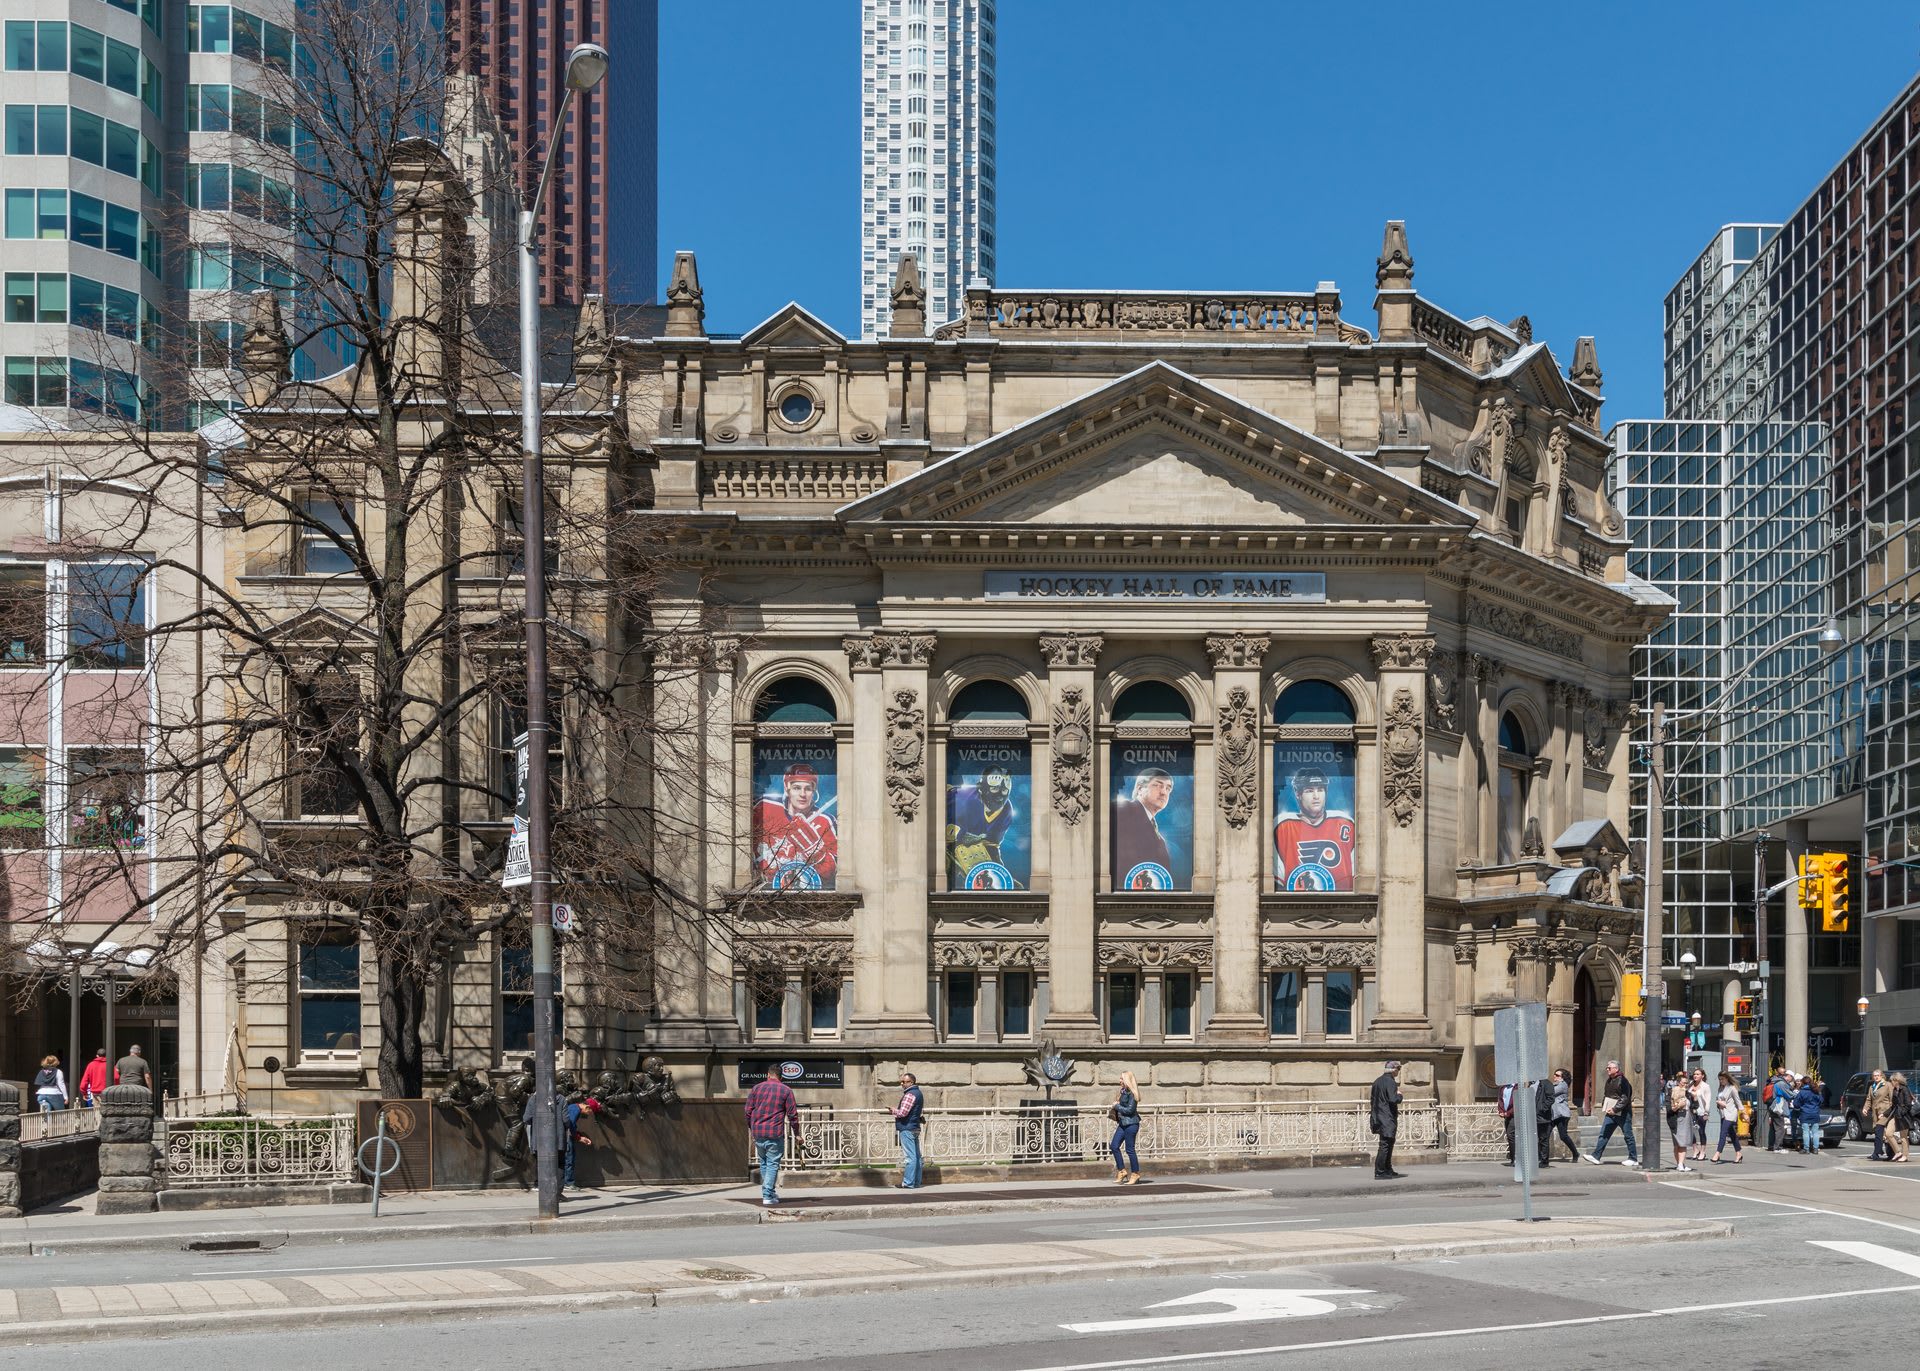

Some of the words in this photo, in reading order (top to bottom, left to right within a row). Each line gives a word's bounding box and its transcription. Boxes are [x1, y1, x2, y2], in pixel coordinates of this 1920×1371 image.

[1019, 578, 1113, 597] HOCKEY
[1122, 578, 1183, 597] HALL
[1193, 578, 1223, 597] OF
[1232, 578, 1292, 597] FAME
[759, 748, 836, 760] MAKAROV
[958, 749, 1021, 761] VACHON
[1123, 749, 1177, 764] QUINN
[1279, 751, 1344, 763] LINDROS
[508, 844, 526, 863] OCKEY
